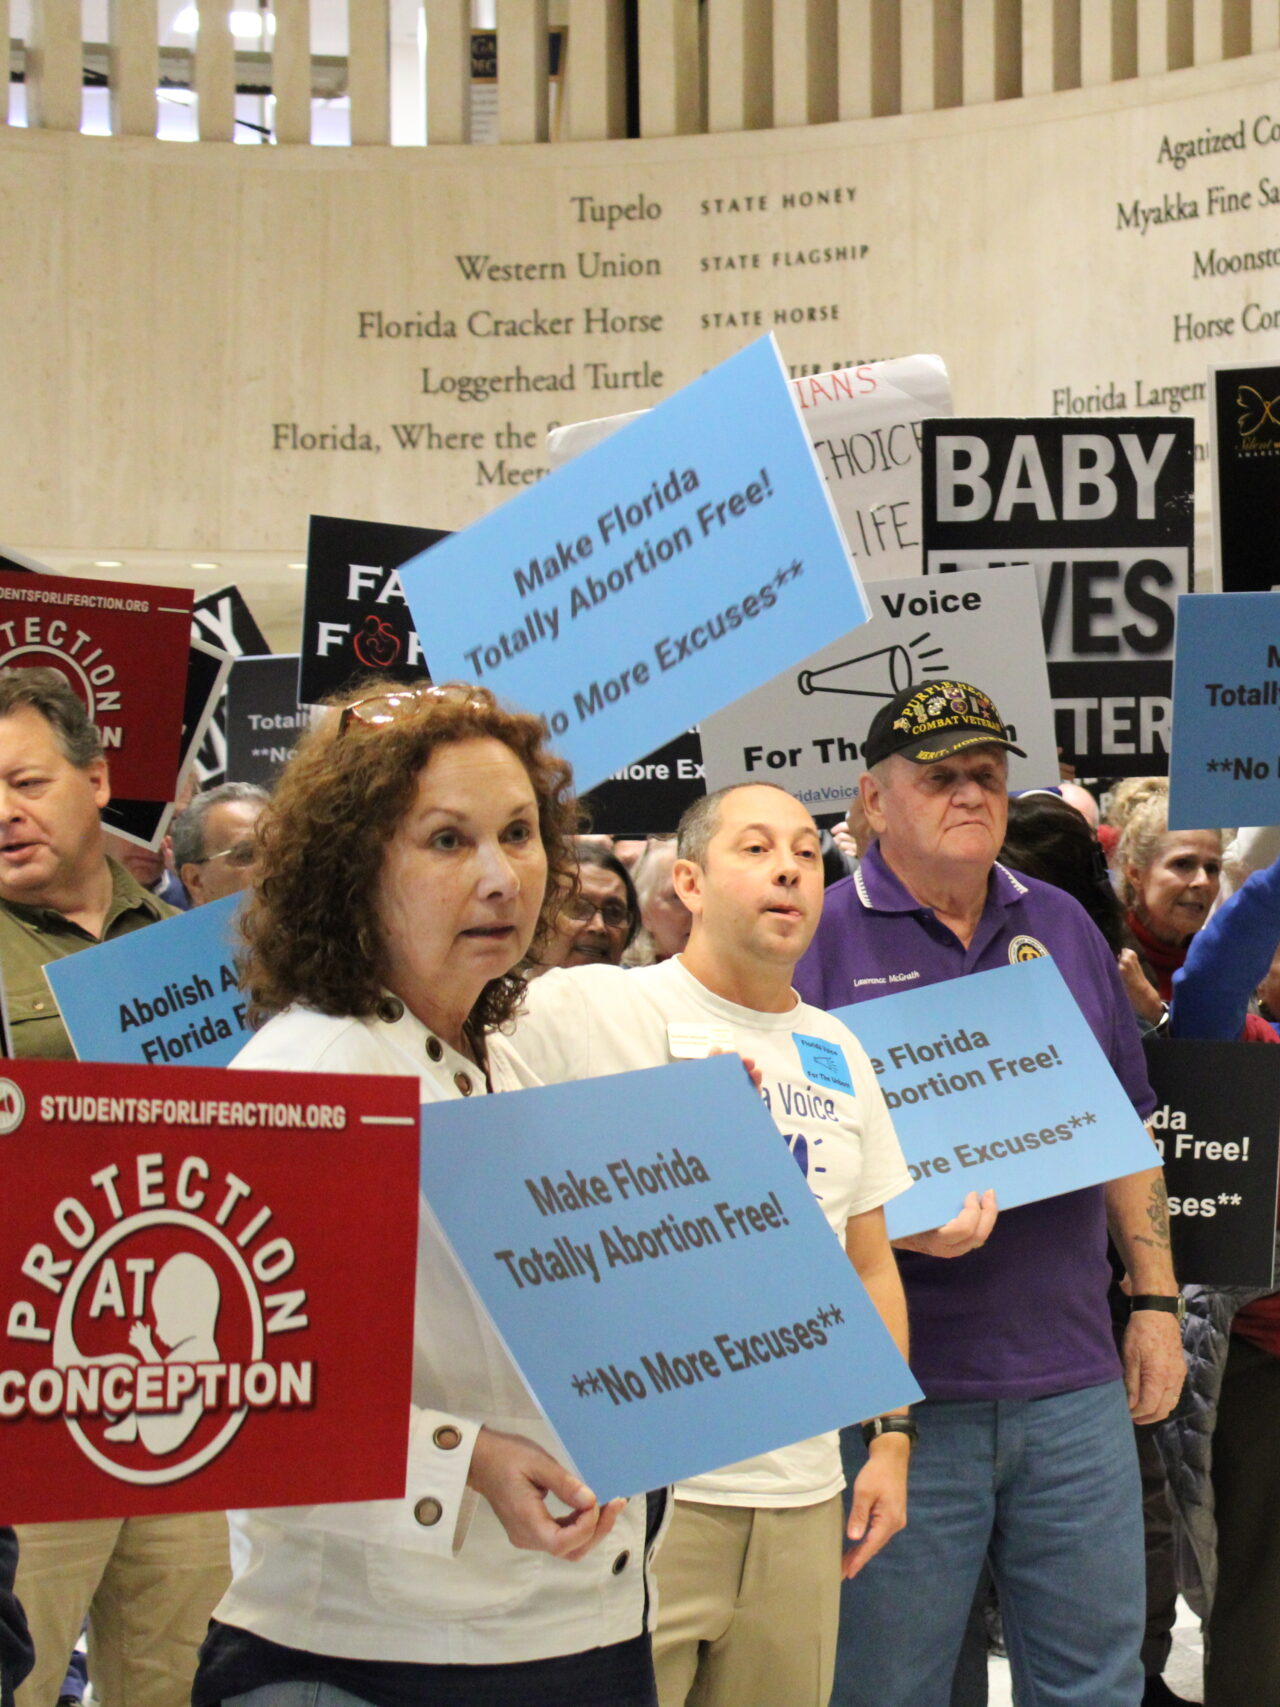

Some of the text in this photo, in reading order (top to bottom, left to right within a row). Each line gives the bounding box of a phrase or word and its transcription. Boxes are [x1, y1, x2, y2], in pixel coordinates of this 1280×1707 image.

[1157, 120, 1245, 169] Agatized
[570, 193, 662, 230] Tupelo
[700, 187, 858, 216] STATE HONEY
[1116, 193, 1199, 236] Myakka
[1207, 185, 1252, 216] Fine
[455, 252, 662, 282] Western Union
[700, 245, 870, 272] STATE FLAGSHIP
[357, 307, 663, 339] Florida Cracker Horse
[701, 304, 840, 330] STATE HORSE
[1173, 311, 1235, 343] Horse
[421, 361, 664, 402] Loggerhead Turtle
[1052, 380, 1127, 416] Florida
[271, 422, 381, 454] Florida,
[391, 422, 484, 451] Where
[495, 421, 537, 450] the
[935, 433, 1177, 524] BABY
[513, 467, 700, 598] Make Florida
[464, 606, 561, 678] Totally
[569, 526, 693, 620] Abortion
[699, 467, 776, 540] Free!
[881, 589, 982, 619] Voice
[573, 662, 650, 727] More
[902, 681, 953, 717] PURPLE
[912, 716, 959, 735] COMBAT
[743, 744, 803, 772] For
[888, 970, 921, 983] McGrath
[118, 974, 215, 1032] Abolish
[141, 1015, 233, 1065] Florida
[887, 1028, 990, 1073] Florida
[883, 1063, 987, 1110] bortion
[991, 1043, 1064, 1084] Free!
[40, 1096, 346, 1129] STUDENTSFORLIFEACTION.ORG
[778, 1082, 840, 1122] Voice
[1175, 1133, 1250, 1162] Free!
[525, 1147, 711, 1217] Make Florida
[7, 1152, 308, 1342] PROTECTION
[493, 1191, 791, 1289] Totally Abortion Free!
[89, 1258, 155, 1318] AT
[0, 1361, 312, 1417] CONCEPTION
[642, 1348, 722, 1395] More
